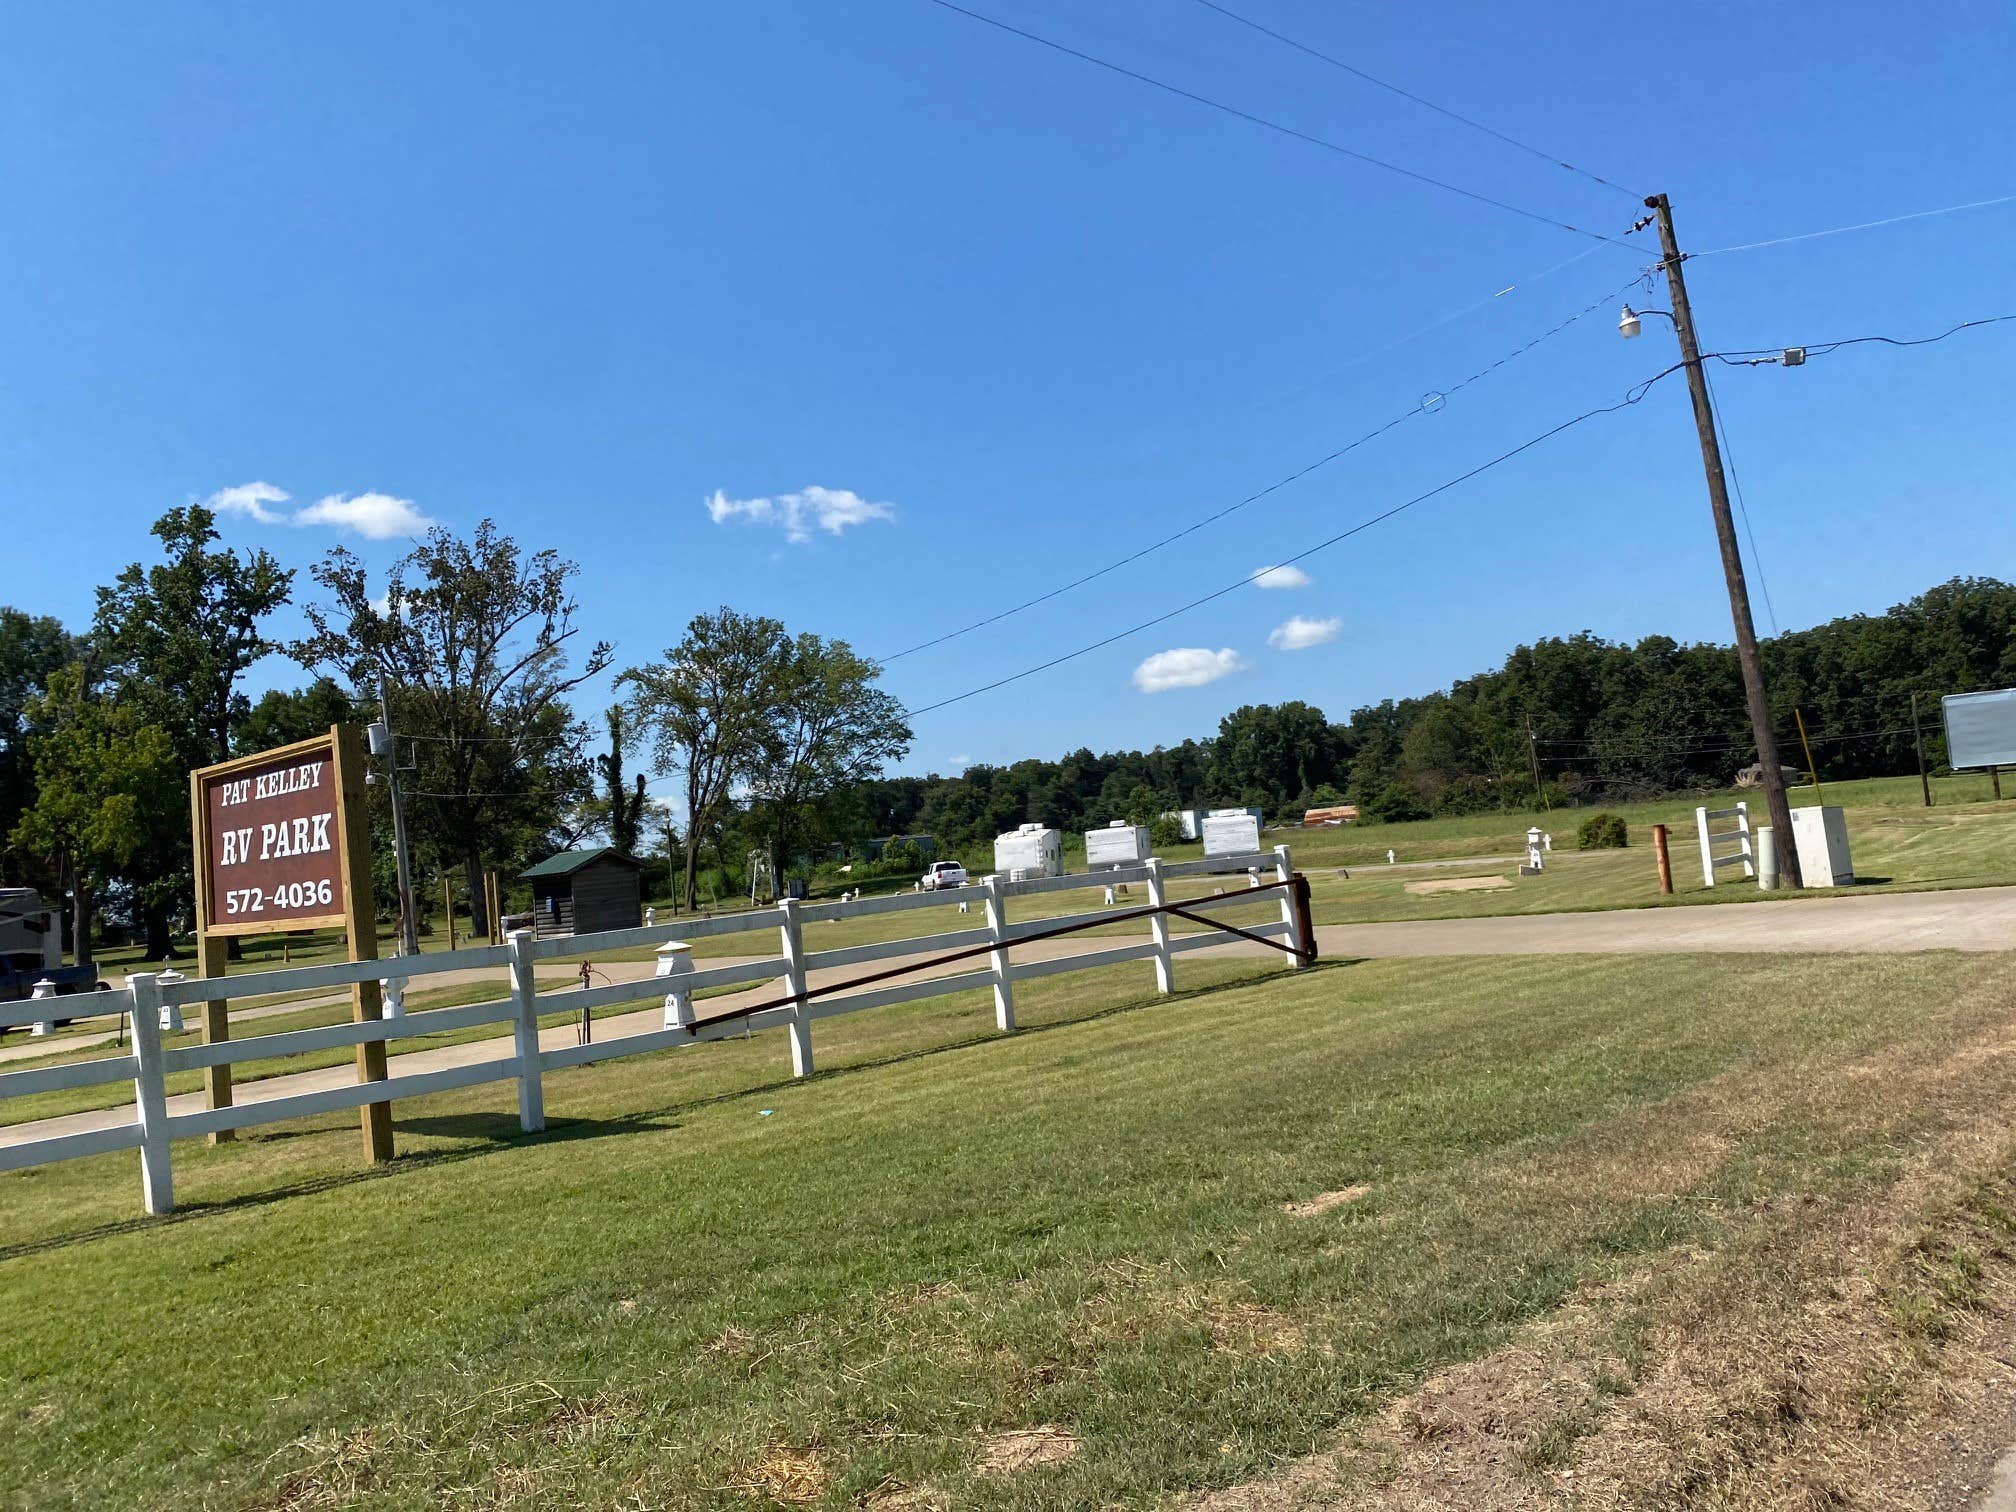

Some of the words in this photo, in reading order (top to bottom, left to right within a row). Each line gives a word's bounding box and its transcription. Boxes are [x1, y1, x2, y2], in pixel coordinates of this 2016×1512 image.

[221, 779, 251, 807] PAT
[255, 761, 323, 799] KELLEY
[220, 827, 253, 866] RV
[259, 812, 332, 860] PARK
[226, 878, 333, 915] 572-4036
